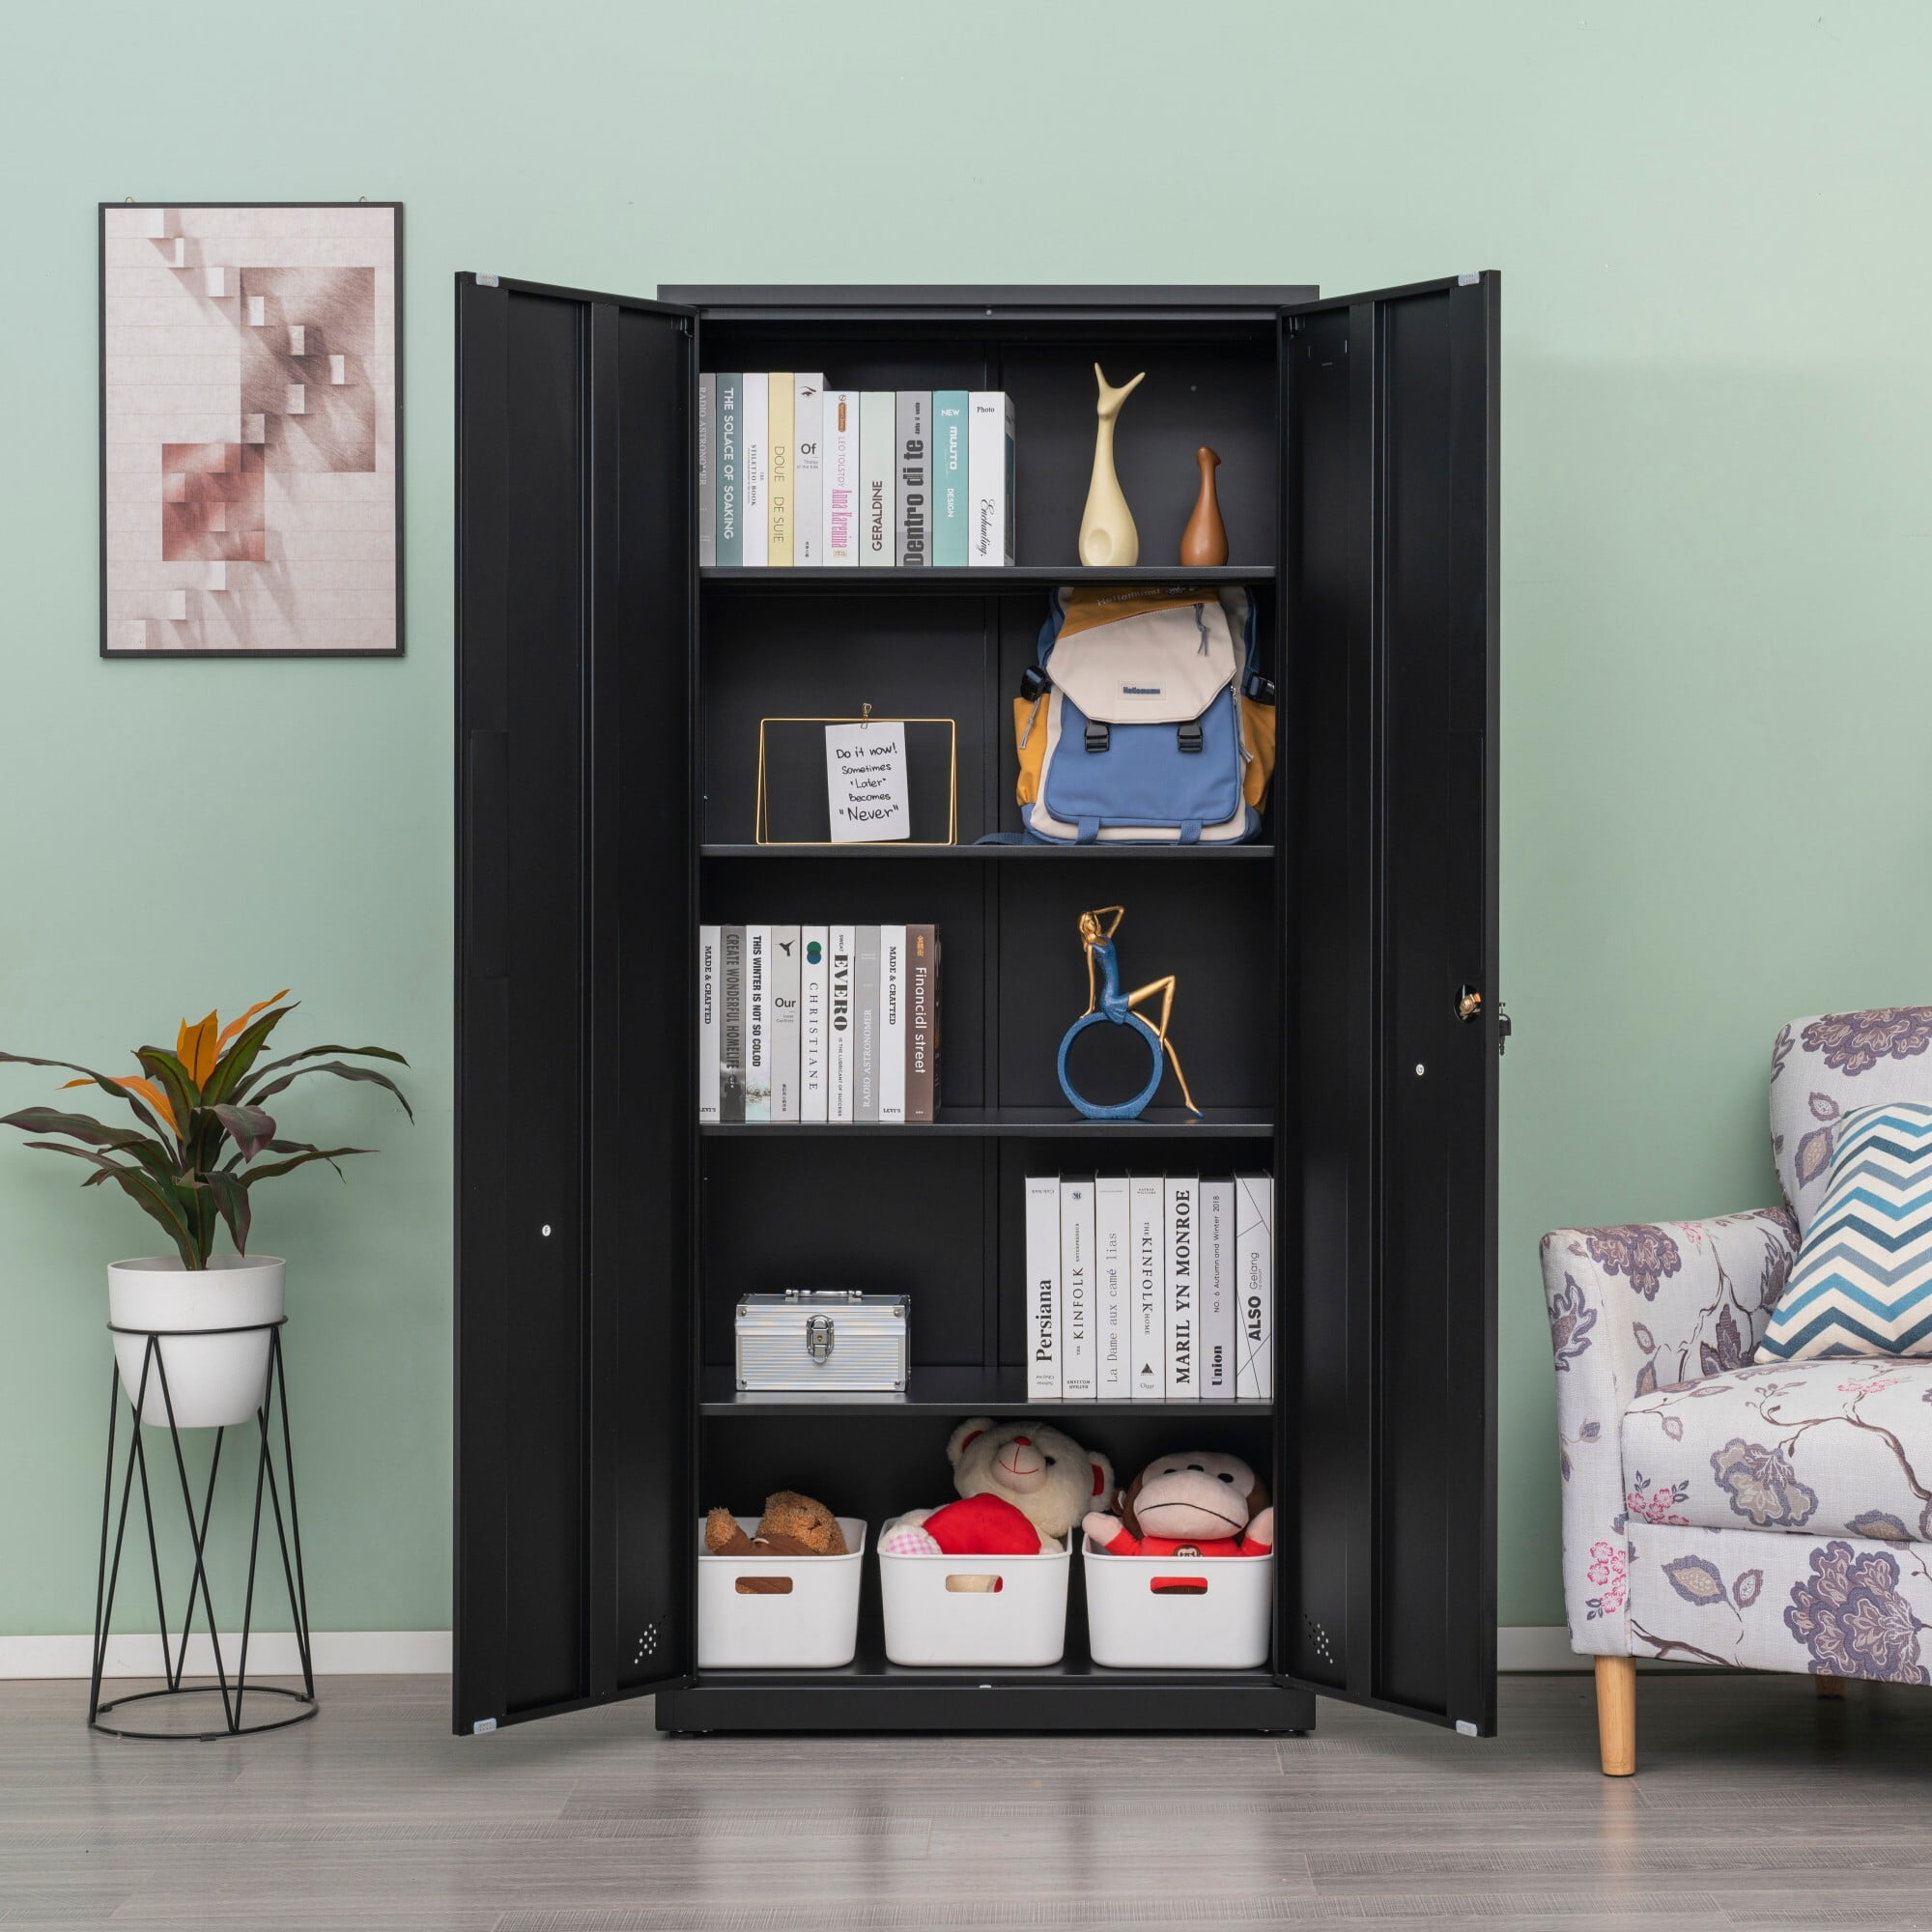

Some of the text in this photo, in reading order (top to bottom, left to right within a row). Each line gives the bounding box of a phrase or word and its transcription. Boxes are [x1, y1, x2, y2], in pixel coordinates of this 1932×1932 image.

[724, 387, 734, 539] THE SOLACE OF SOAKING
[801, 443, 816, 455] Of
[774, 445, 785, 543] DOUE DE SUIE
[833, 489, 852, 508] Anna
[902, 440, 923, 566] Dentro di te
[832, 512, 852, 548] Karenina
[872, 480, 883, 552] GERALDINE
[837, 742, 897, 758] Do it now!
[842, 763, 892, 775] Sometimes
[838, 804, 899, 822] "Never"
[753, 935, 761, 955] THIS
[752, 957, 761, 991] WINTER
[834, 954, 848, 1031] EVERO
[725, 934, 740, 1069] CREATE WONDERFUL HOMELIFE
[752, 1005, 761, 1022] NOT
[775, 998, 797, 1008] Our
[752, 1025, 761, 1037] SO
[809, 982, 819, 1091] CHRISTIANE
[752, 1038, 761, 1067] COLOD
[863, 1009, 872, 1108] RADIO ASTRONOMER
[915, 1032, 926, 1074] street
[1106, 1233, 1118, 1260] lias
[1142, 1237, 1152, 1313] KINFOLK
[1176, 1189, 1190, 1384] MARIL YN MONROE
[1250, 1252, 1260, 1290] Gelang
[1036, 1279, 1052, 1363] Persiana
[1073, 1266, 1084, 1340] KINFOLK
[1248, 1295, 1262, 1342] ALSO
[1107, 1332, 1118, 1361] Dame
[1212, 1345, 1222, 1385] Union
[1107, 1369, 1118, 1382] La
